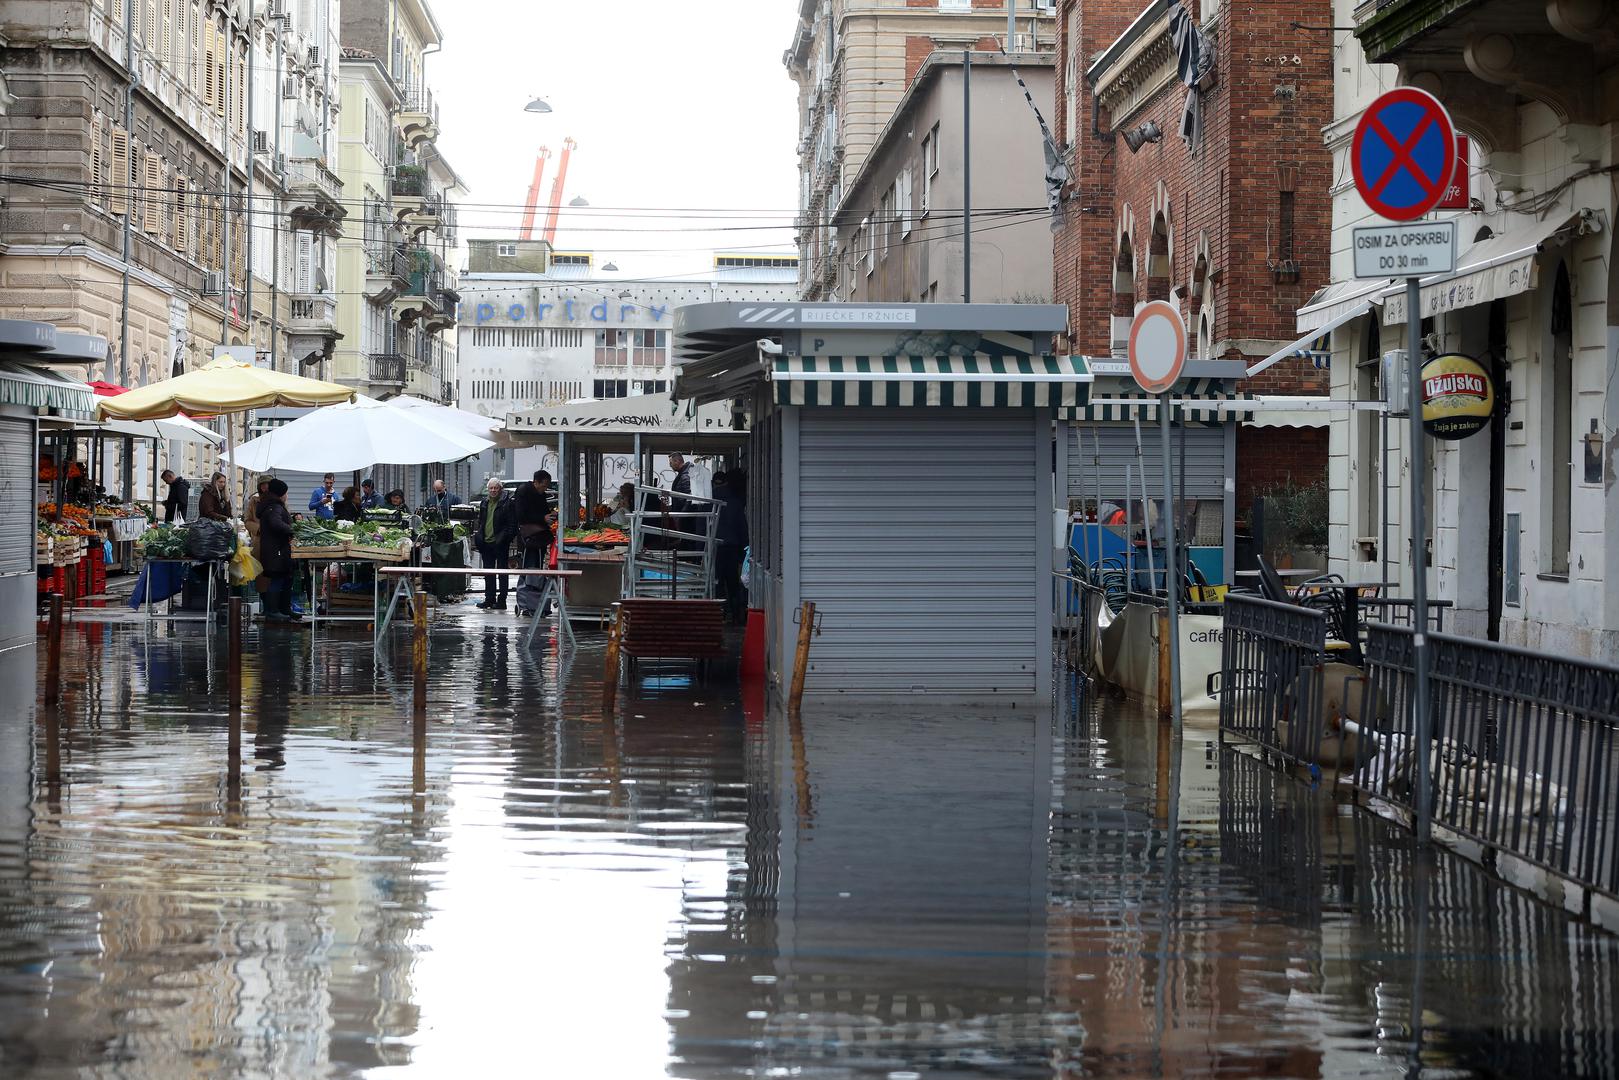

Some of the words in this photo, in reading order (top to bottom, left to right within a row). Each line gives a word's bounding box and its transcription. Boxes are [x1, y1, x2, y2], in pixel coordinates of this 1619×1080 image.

[1357, 236, 1382, 250] OSIM
[1385, 234, 1399, 248] ZA
[1401, 231, 1450, 247] OPSKRBU
[1380, 256, 1395, 269] DO
[1397, 255, 1409, 268] 30
[1411, 254, 1429, 267] min
[807, 310, 854, 321] RIJEČKE
[861, 309, 911, 321] TRŽNICE
[1425, 374, 1483, 397] Ožujsko
[515, 416, 569, 426] PLACA
[1434, 422, 1449, 432] Žuja
[1450, 422, 1457, 431] je
[1459, 421, 1479, 430] zakon
